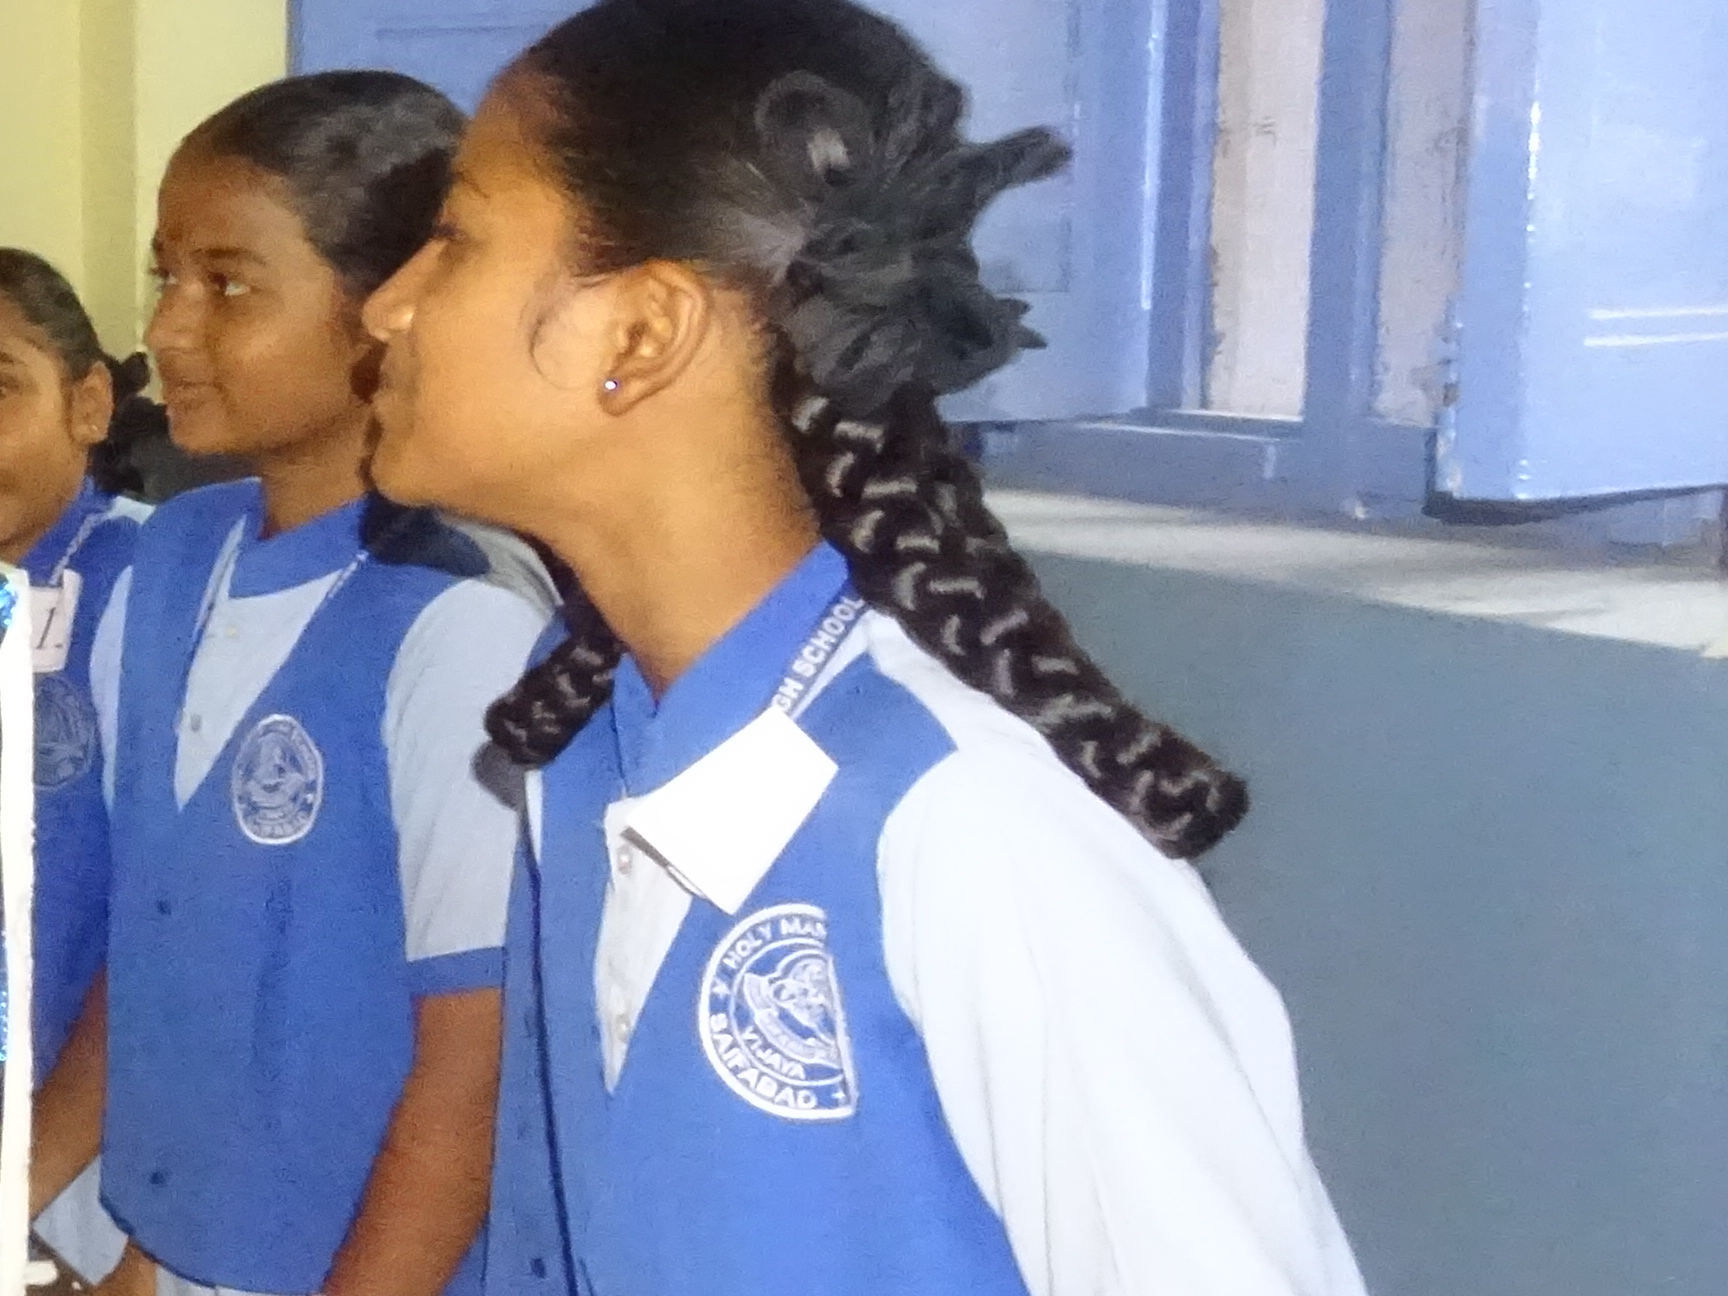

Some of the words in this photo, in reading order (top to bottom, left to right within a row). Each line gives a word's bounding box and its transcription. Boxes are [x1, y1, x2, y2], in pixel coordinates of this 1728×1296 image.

[792, 596, 865, 678] SCHOOL
[722, 921, 773, 970] HOLY
[709, 1012, 819, 1110] SAIFABAD
